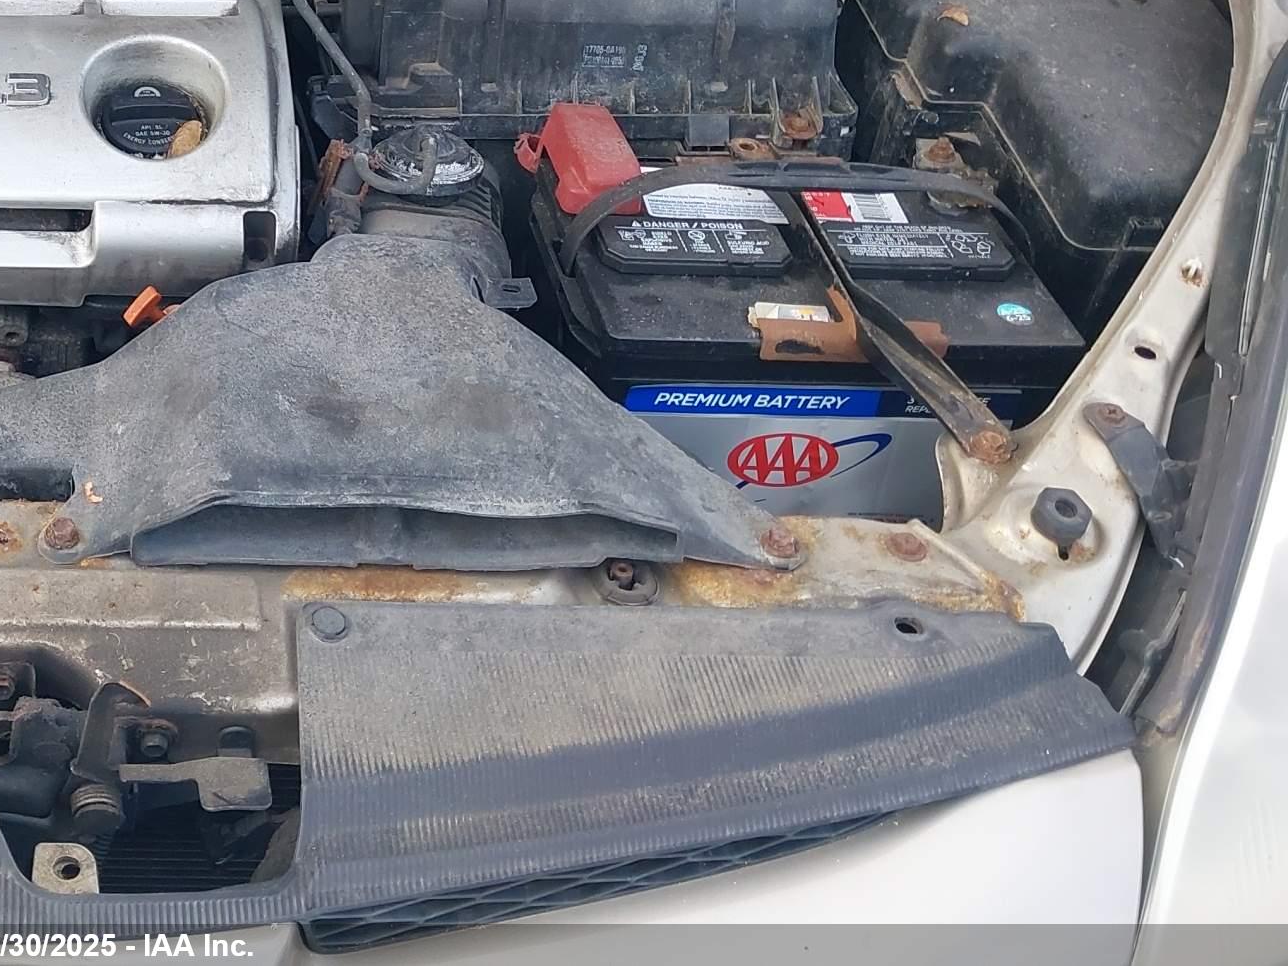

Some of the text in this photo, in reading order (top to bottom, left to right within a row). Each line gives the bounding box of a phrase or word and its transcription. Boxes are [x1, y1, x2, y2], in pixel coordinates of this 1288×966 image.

[642, 221, 690, 229] DANGER
[700, 222, 744, 230] POISON
[654, 392, 851, 410] PREMIUM BATTERY
[734, 435, 833, 485] AAA
